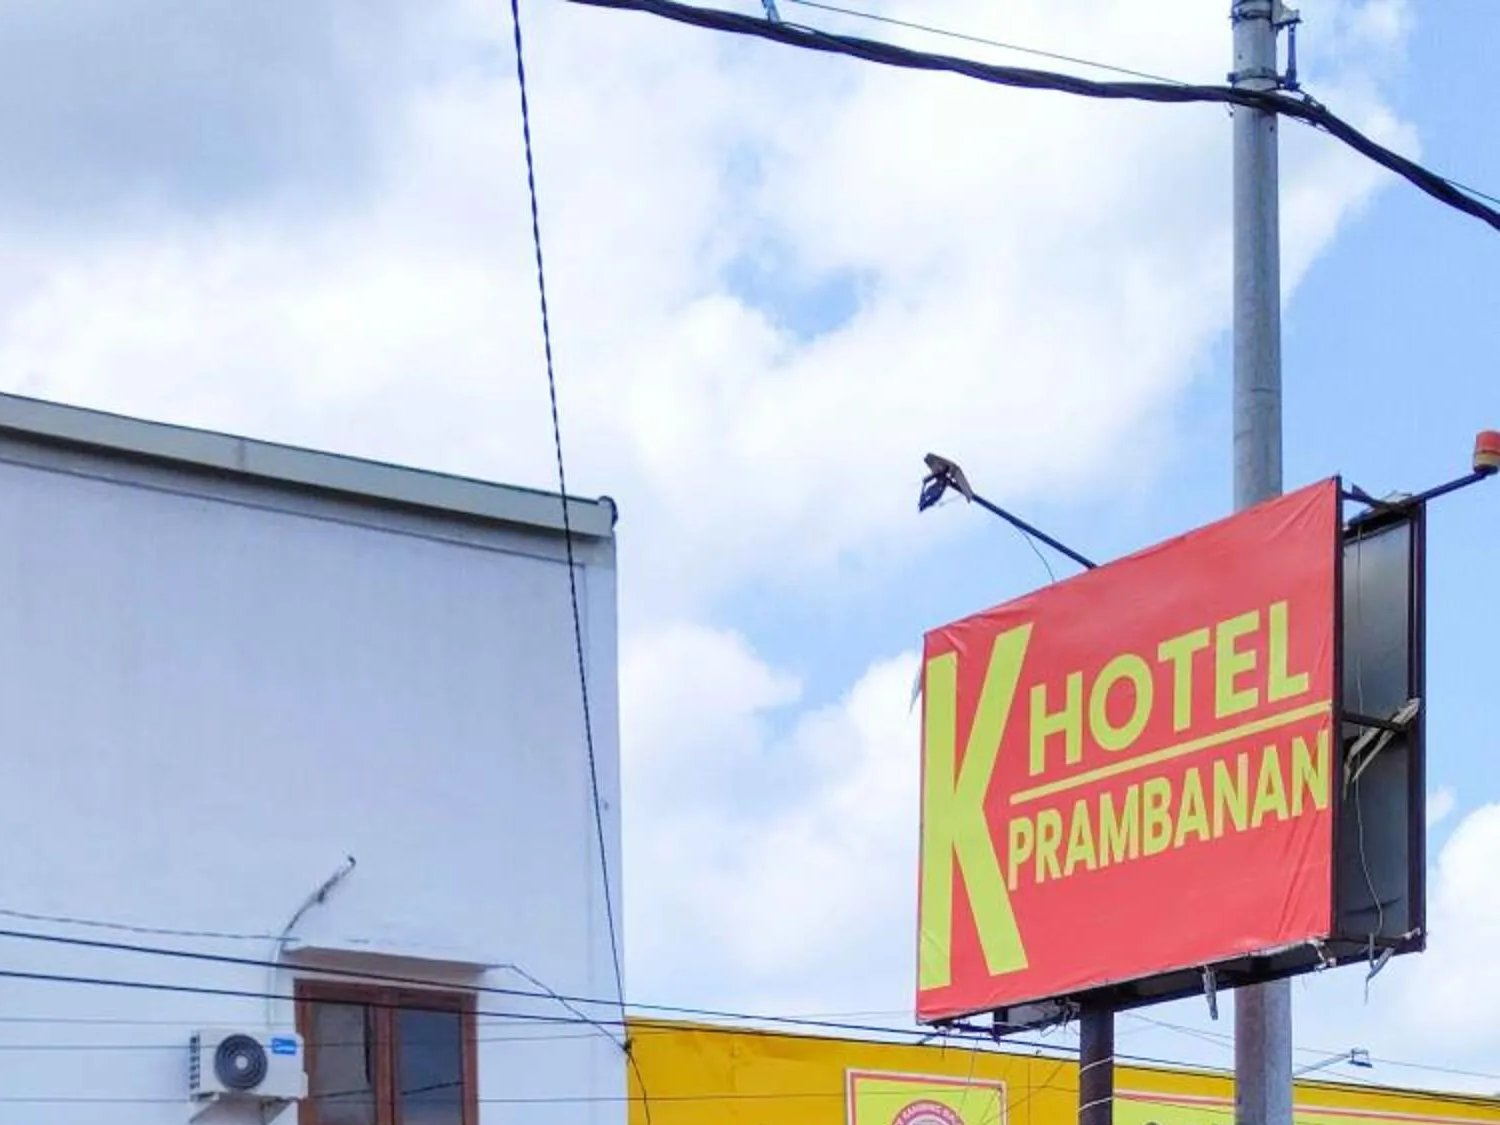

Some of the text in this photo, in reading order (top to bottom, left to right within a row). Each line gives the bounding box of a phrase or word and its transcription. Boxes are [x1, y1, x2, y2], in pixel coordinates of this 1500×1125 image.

[1029, 601, 1309, 776] HOTEL
[919, 622, 1034, 991] K
[1008, 730, 1329, 890] PRAMBANAN
